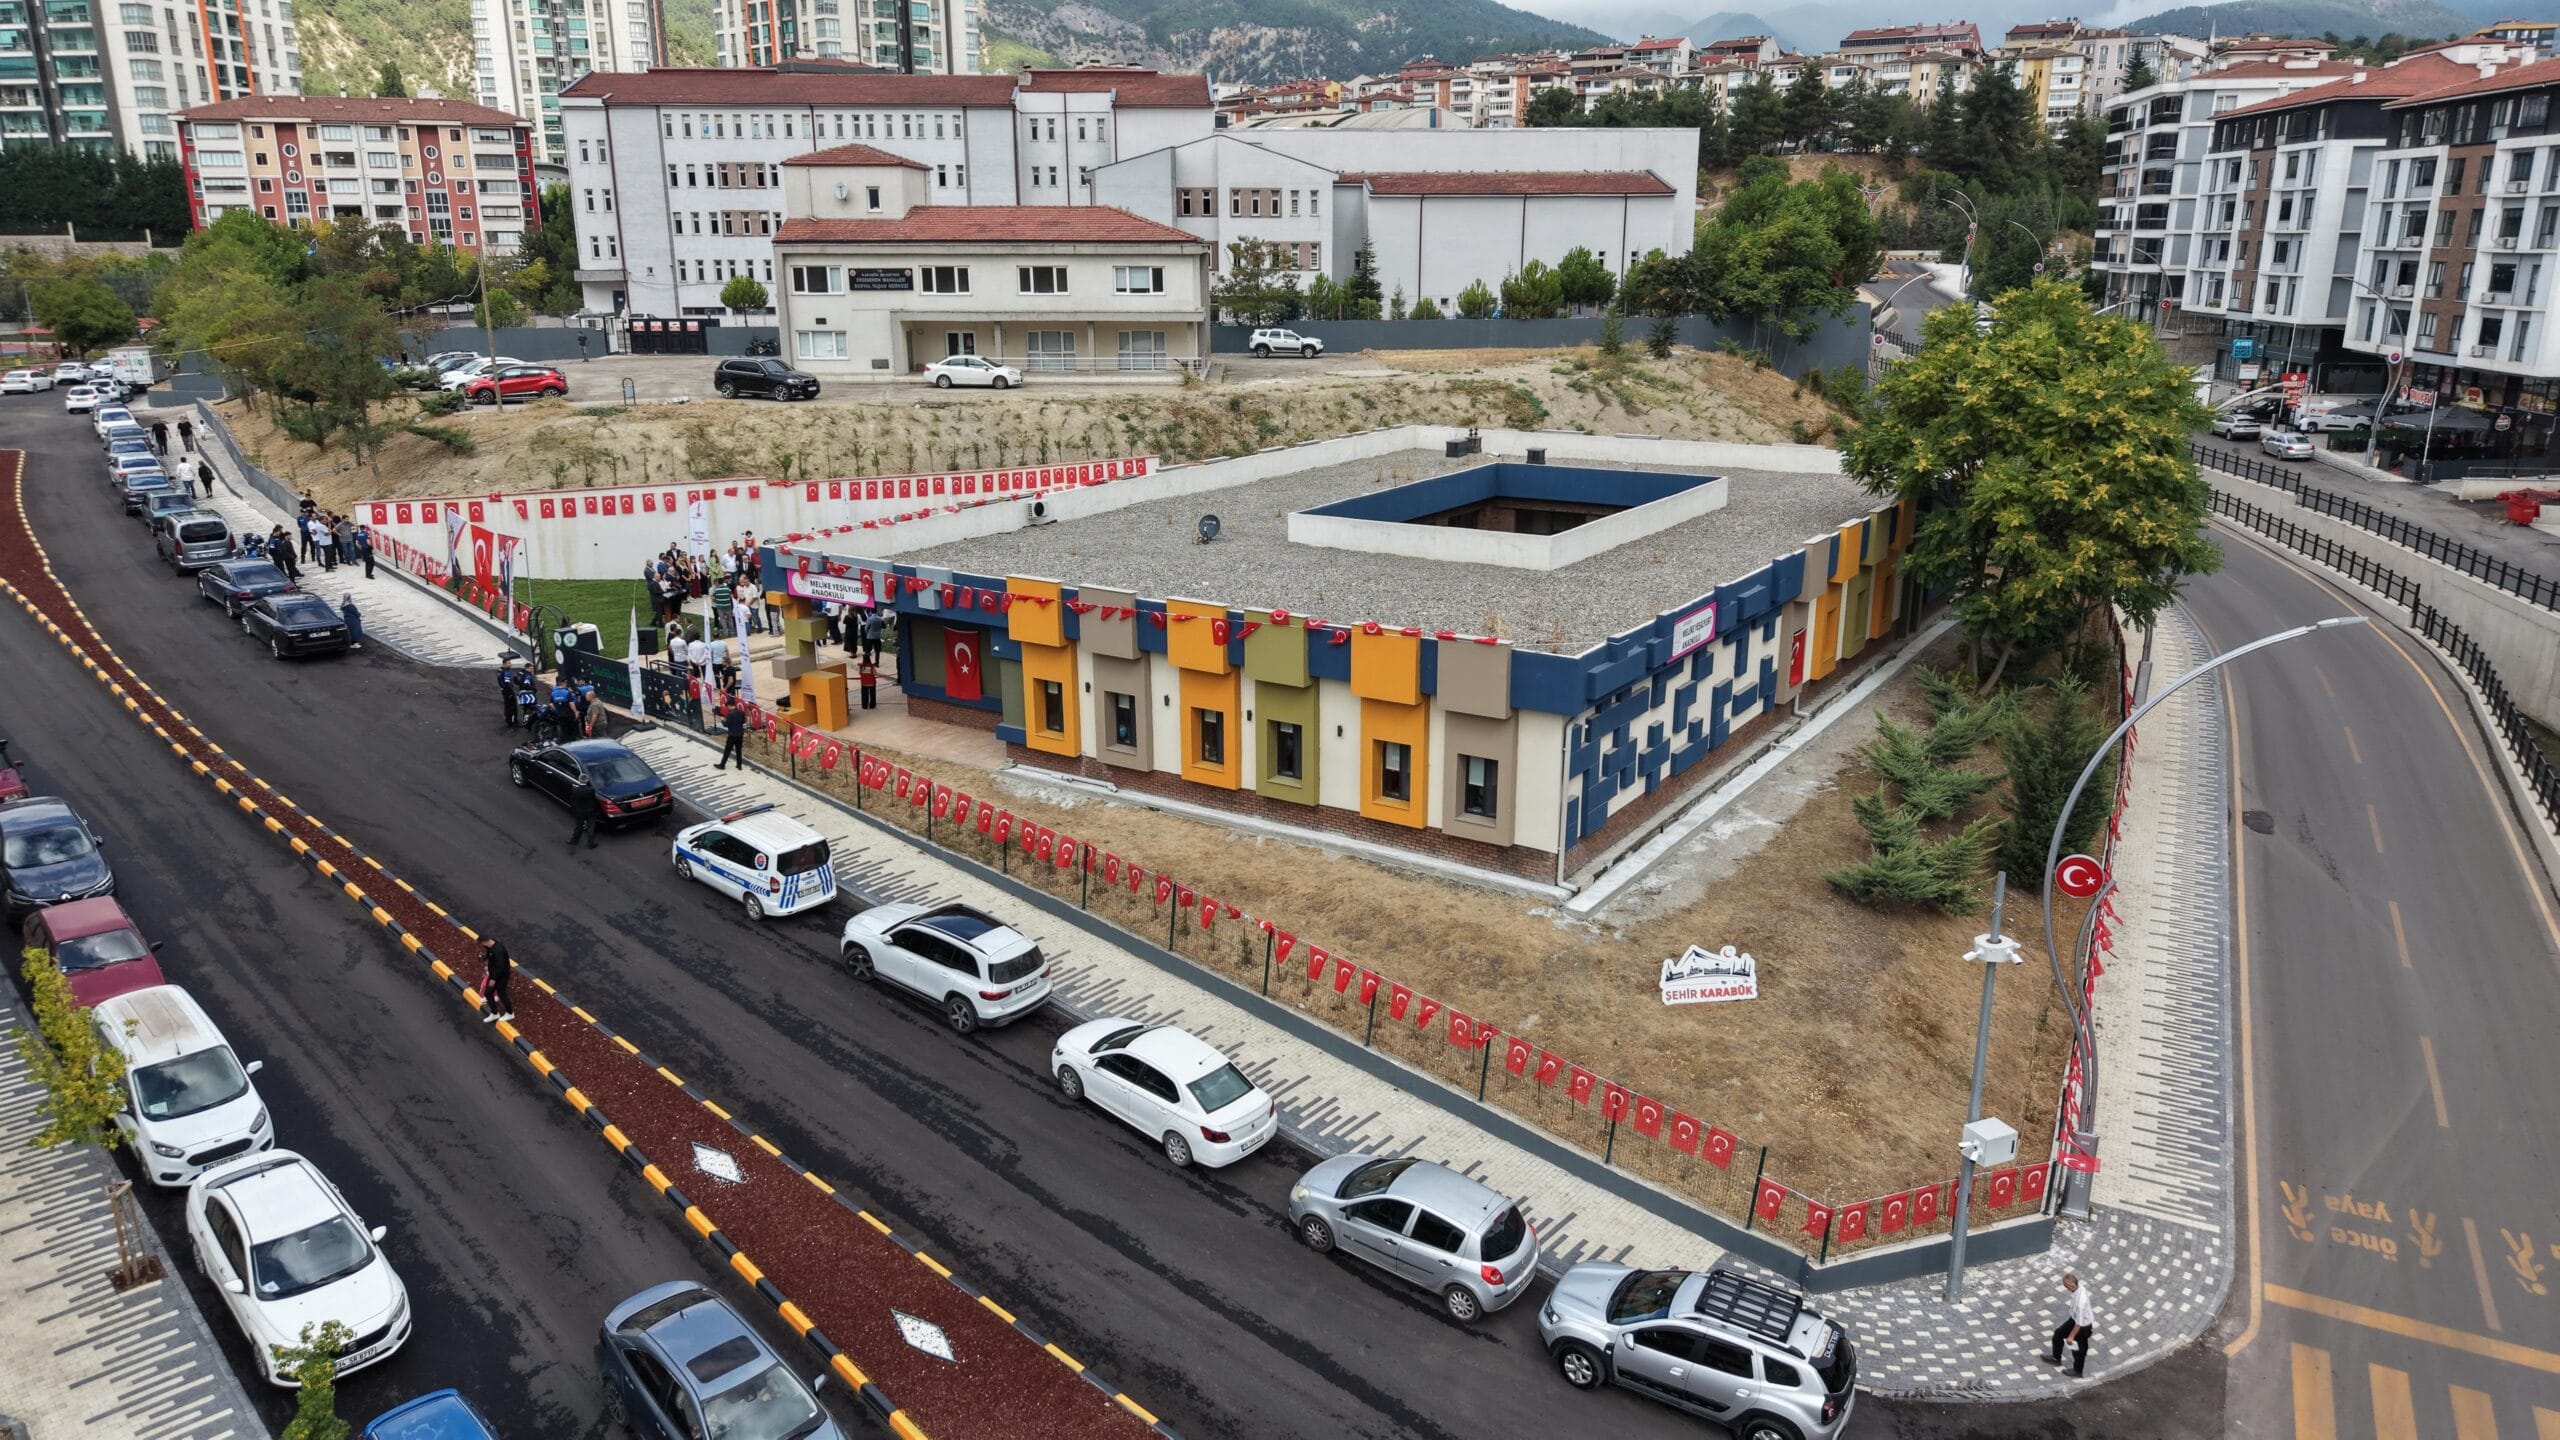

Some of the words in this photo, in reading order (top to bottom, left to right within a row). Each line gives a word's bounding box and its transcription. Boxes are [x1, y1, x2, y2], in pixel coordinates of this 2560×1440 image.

[809, 579, 833, 590] MELİKE
[833, 582, 864, 596] YEŞİLYURT
[811, 589, 845, 600] ANAOKULU
[1665, 989, 1698, 1001] ŞEHİR
[1700, 984, 1753, 999] KARABÜK
[2323, 1194, 2393, 1223] yaya
[2330, 1226, 2398, 1262] önce
[1824, 1330, 1840, 1359] DUSTER
